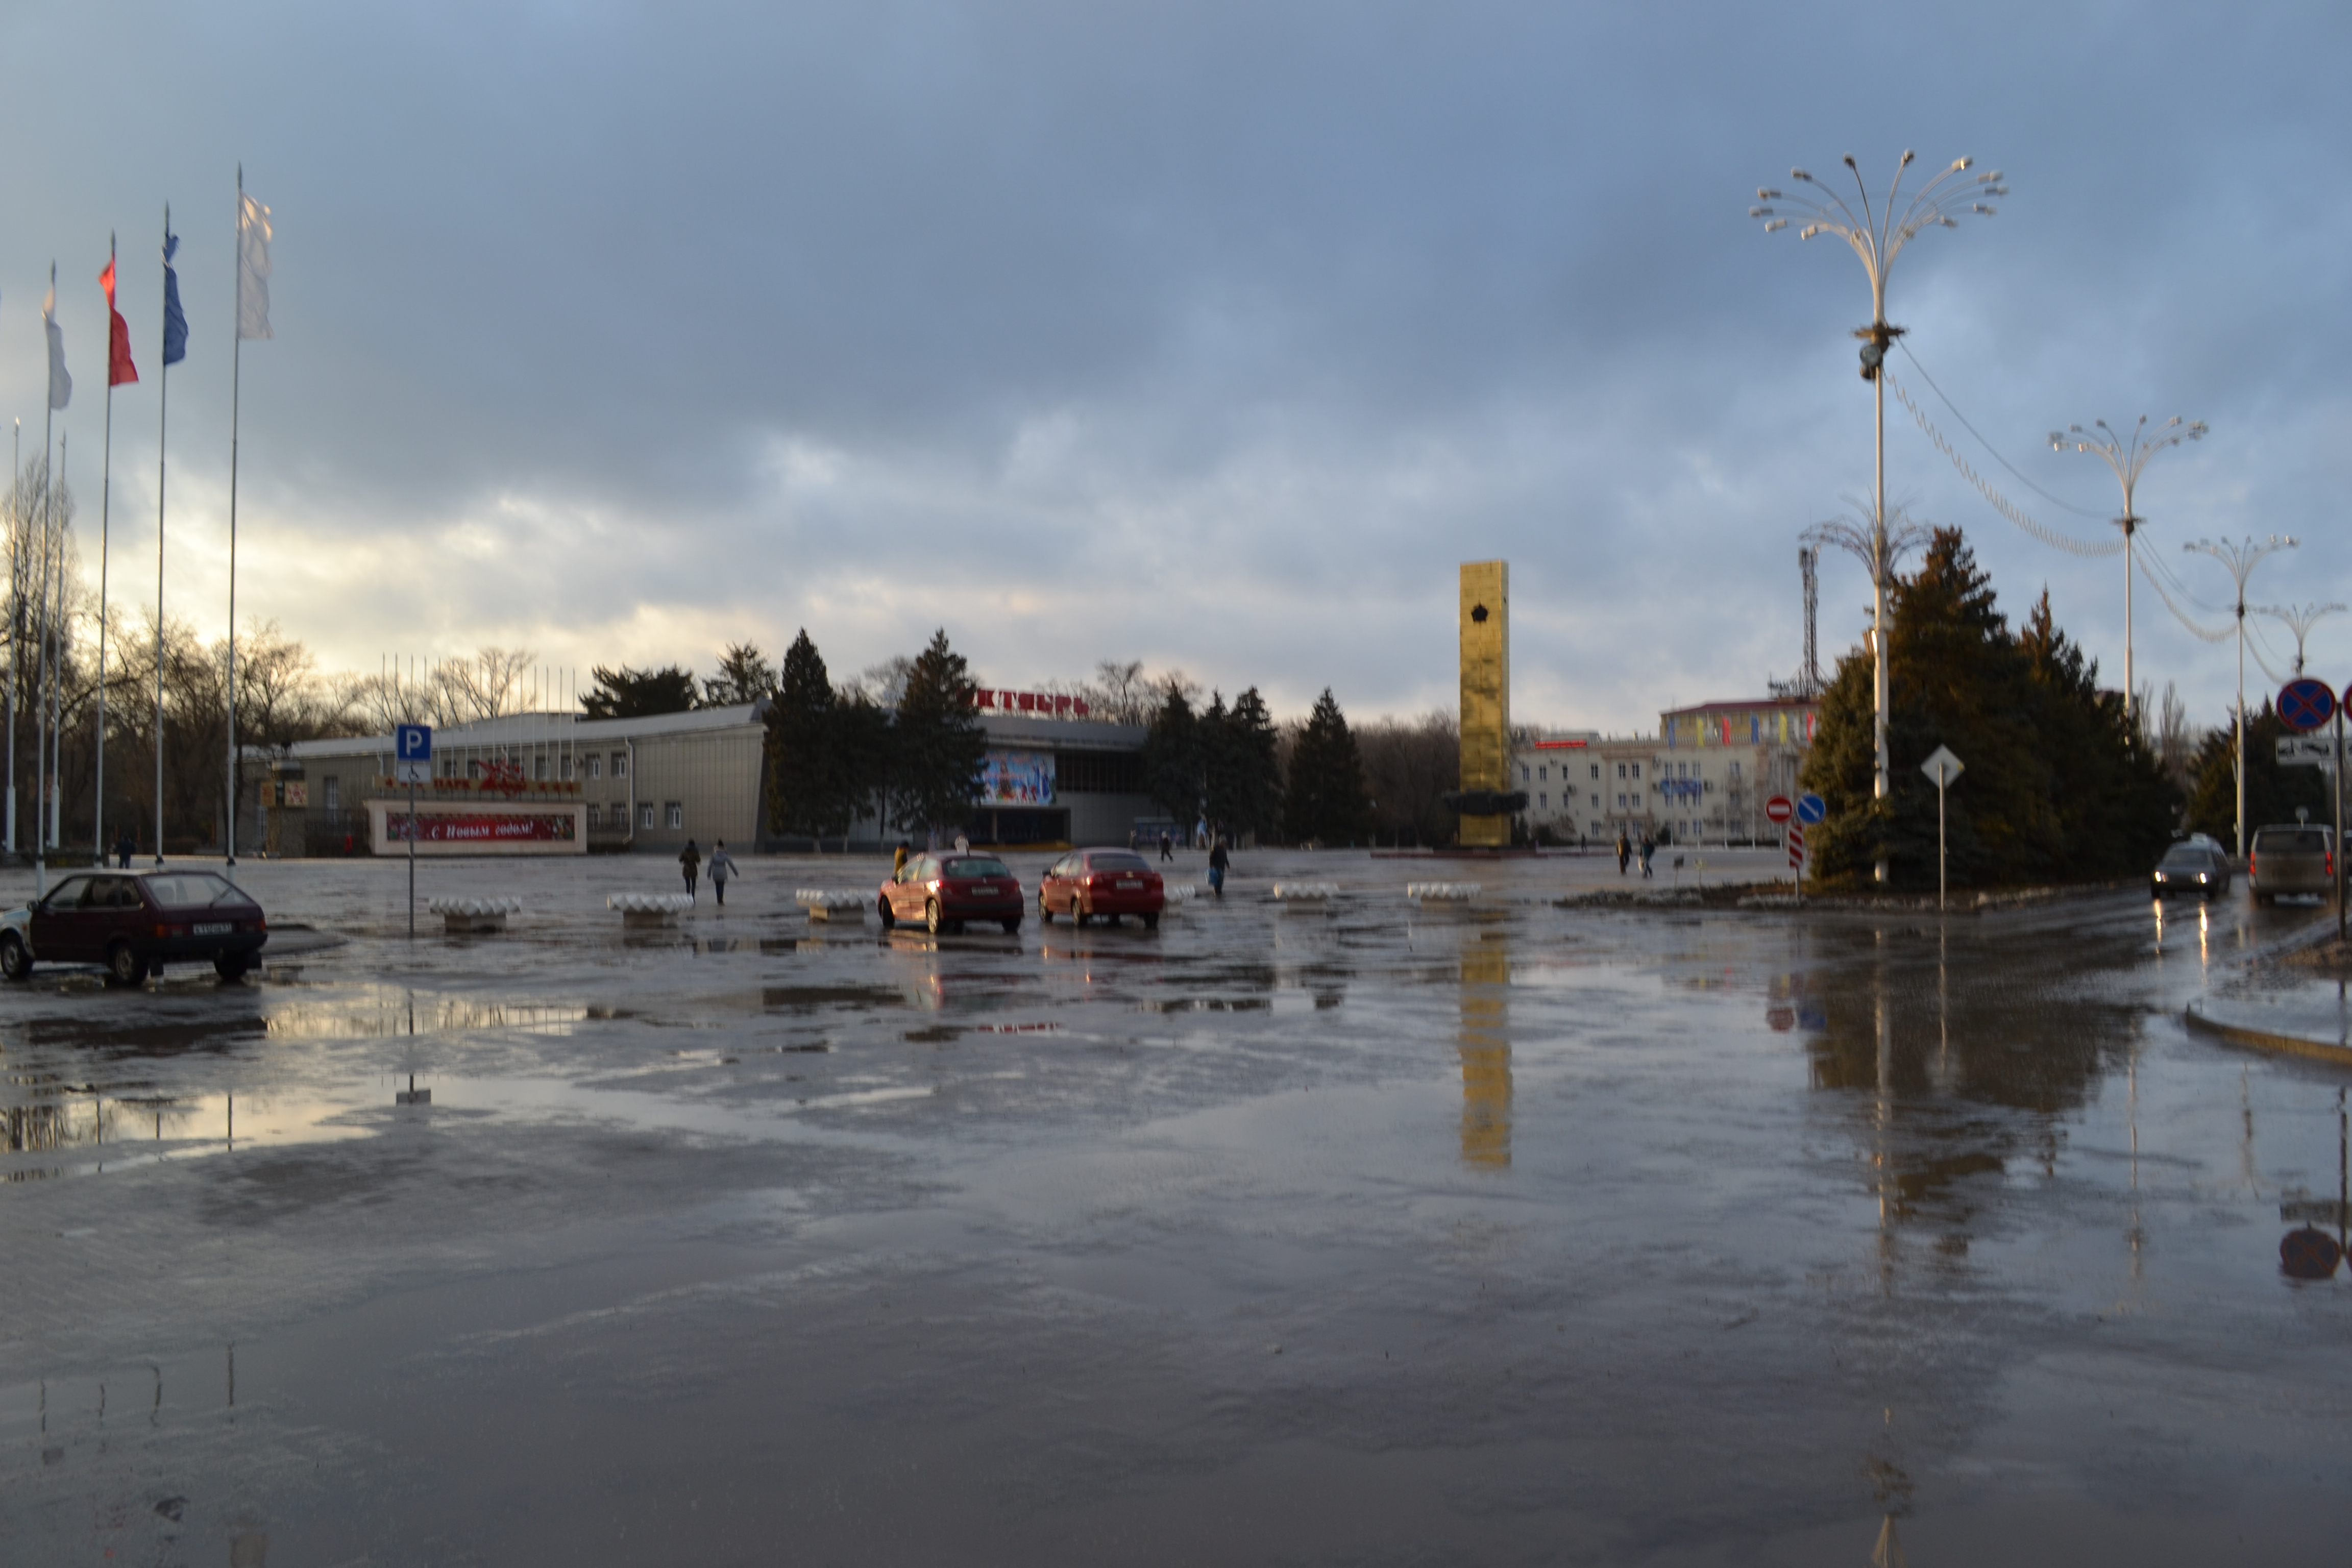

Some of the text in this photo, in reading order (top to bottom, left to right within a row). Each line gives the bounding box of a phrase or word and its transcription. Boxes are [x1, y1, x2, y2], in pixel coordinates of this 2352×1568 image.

[406, 730, 423, 756] P
[434, 778, 470, 790] ПАРК
[447, 824, 489, 839] Новым
[495, 820, 533, 836] годом!
